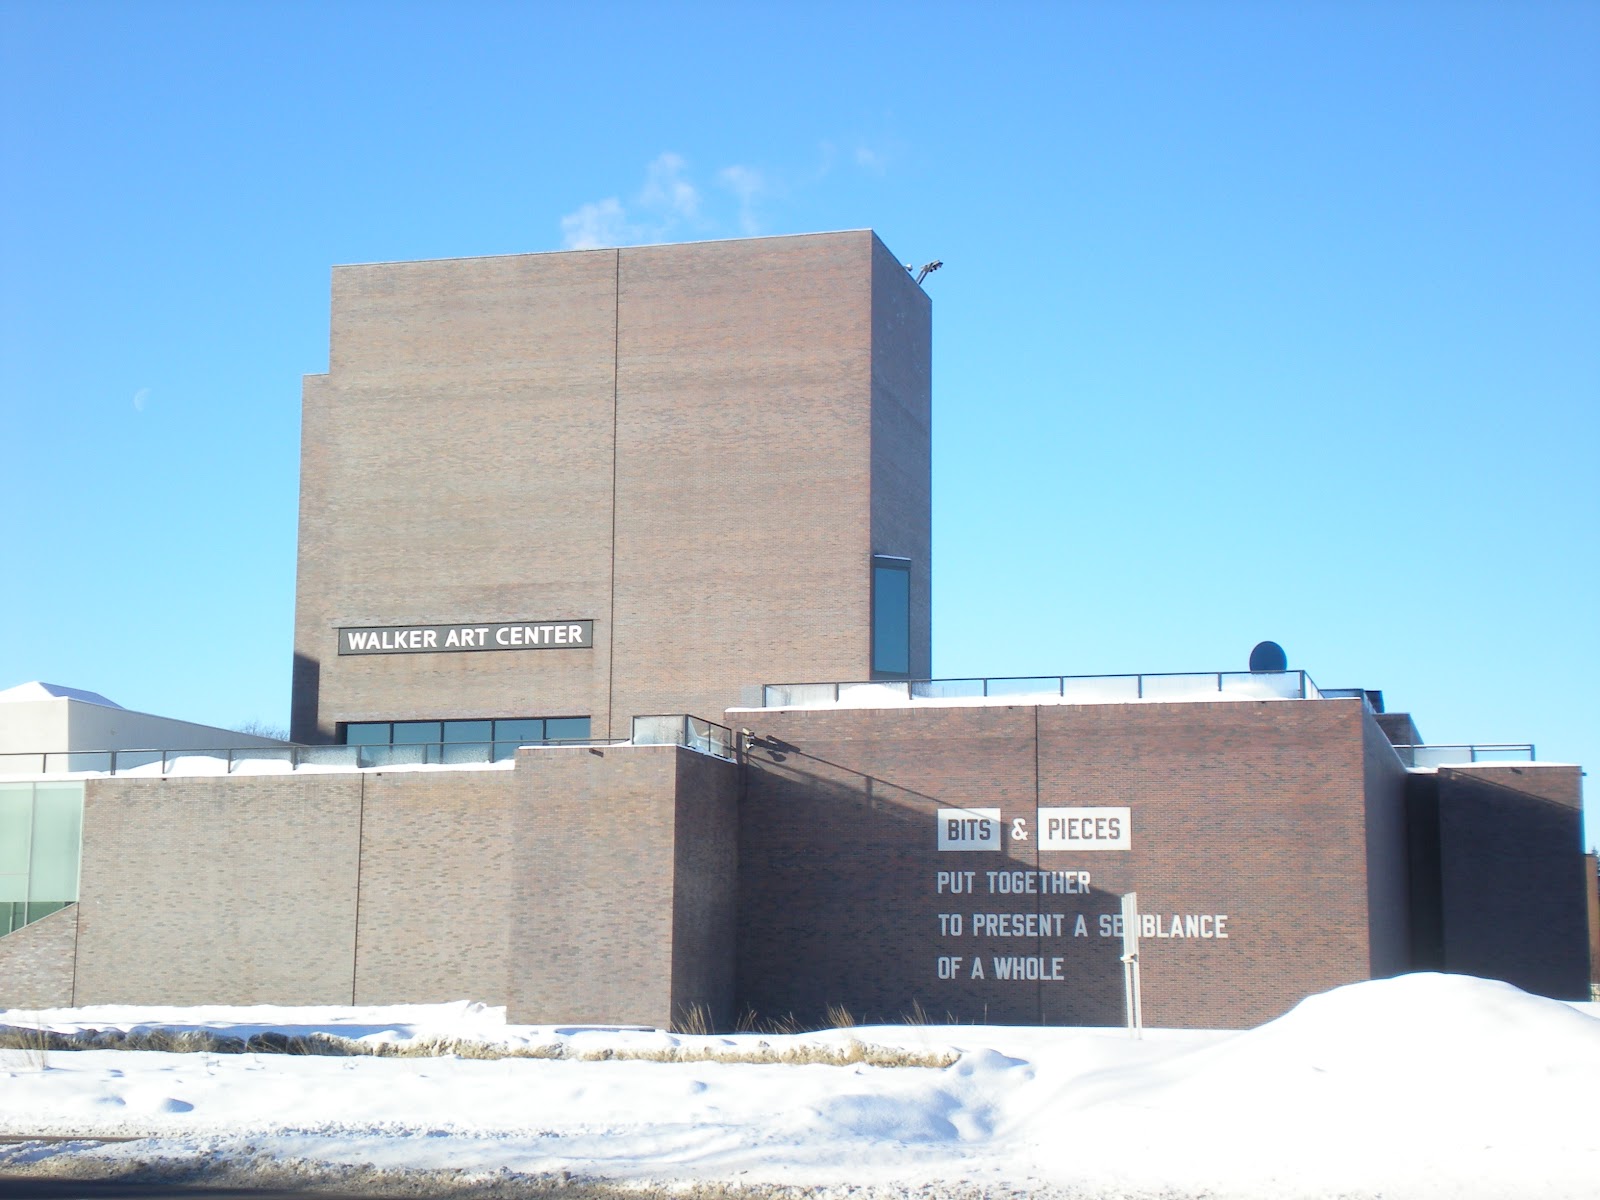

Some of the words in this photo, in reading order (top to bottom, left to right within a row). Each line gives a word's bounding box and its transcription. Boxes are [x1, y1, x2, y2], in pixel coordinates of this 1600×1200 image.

[347, 630, 437, 650] WALKER
[444, 628, 489, 648] ART
[495, 625, 583, 645] CENTER
[947, 818, 991, 841] BITS
[1011, 818, 1029, 841] &
[1048, 818, 1121, 840] PIECES
[937, 871, 976, 894] PUT
[986, 871, 1091, 894] TOGETHER
[938, 914, 962, 937] TO
[973, 914, 1065, 937] PRESENT
[1074, 914, 1089, 938] A
[1099, 914, 1229, 939] SEBLANCE
[938, 957, 962, 980] OF
[971, 957, 985, 981] A
[993, 957, 1065, 981] WHOLE
